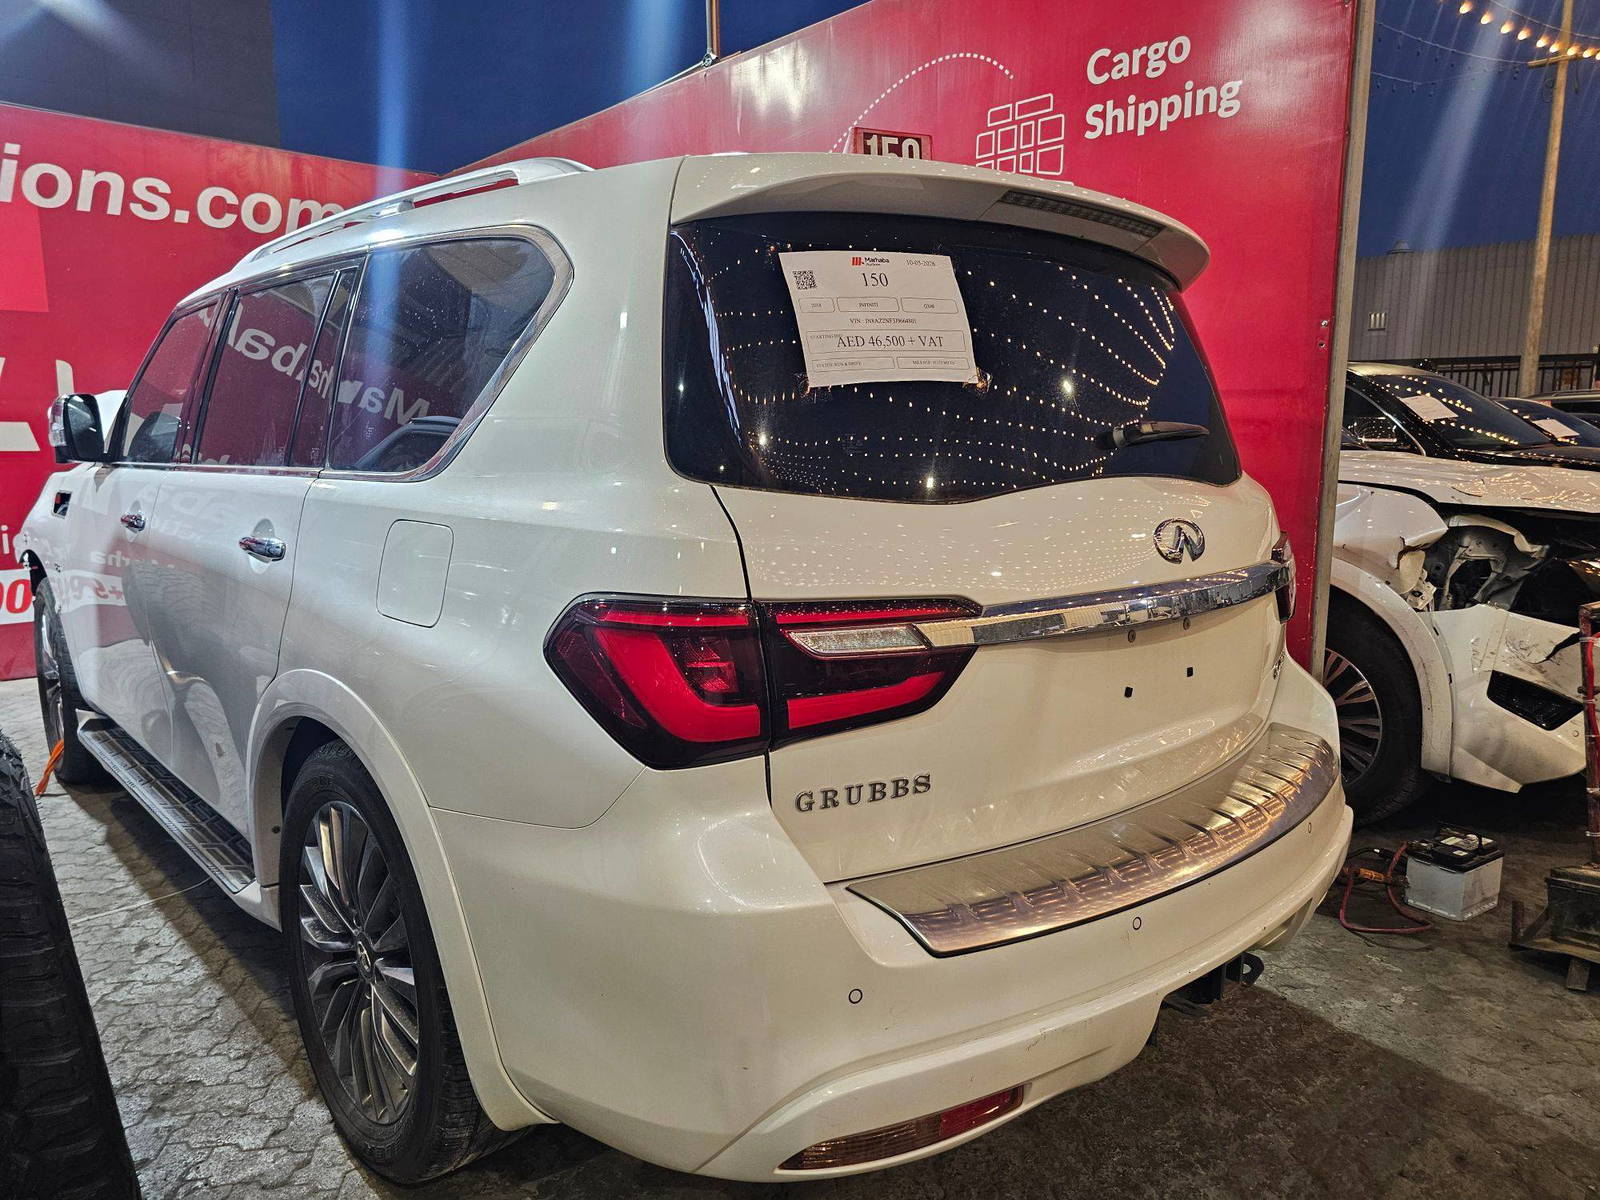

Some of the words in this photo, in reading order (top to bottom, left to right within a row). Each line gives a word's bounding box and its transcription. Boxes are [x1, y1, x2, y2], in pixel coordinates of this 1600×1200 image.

[1086, 35, 1192, 85] Cargo
[1084, 79, 1244, 139] Shipping
[864, 256, 890, 264] Marhaba
[862, 272, 889, 287] 150
[837, 335, 865, 348] AED
[868, 335, 906, 349] 46,500
[909, 336, 916, 345] +
[918, 335, 944, 348] VAT
[795, 772, 932, 813] GRUBBS
